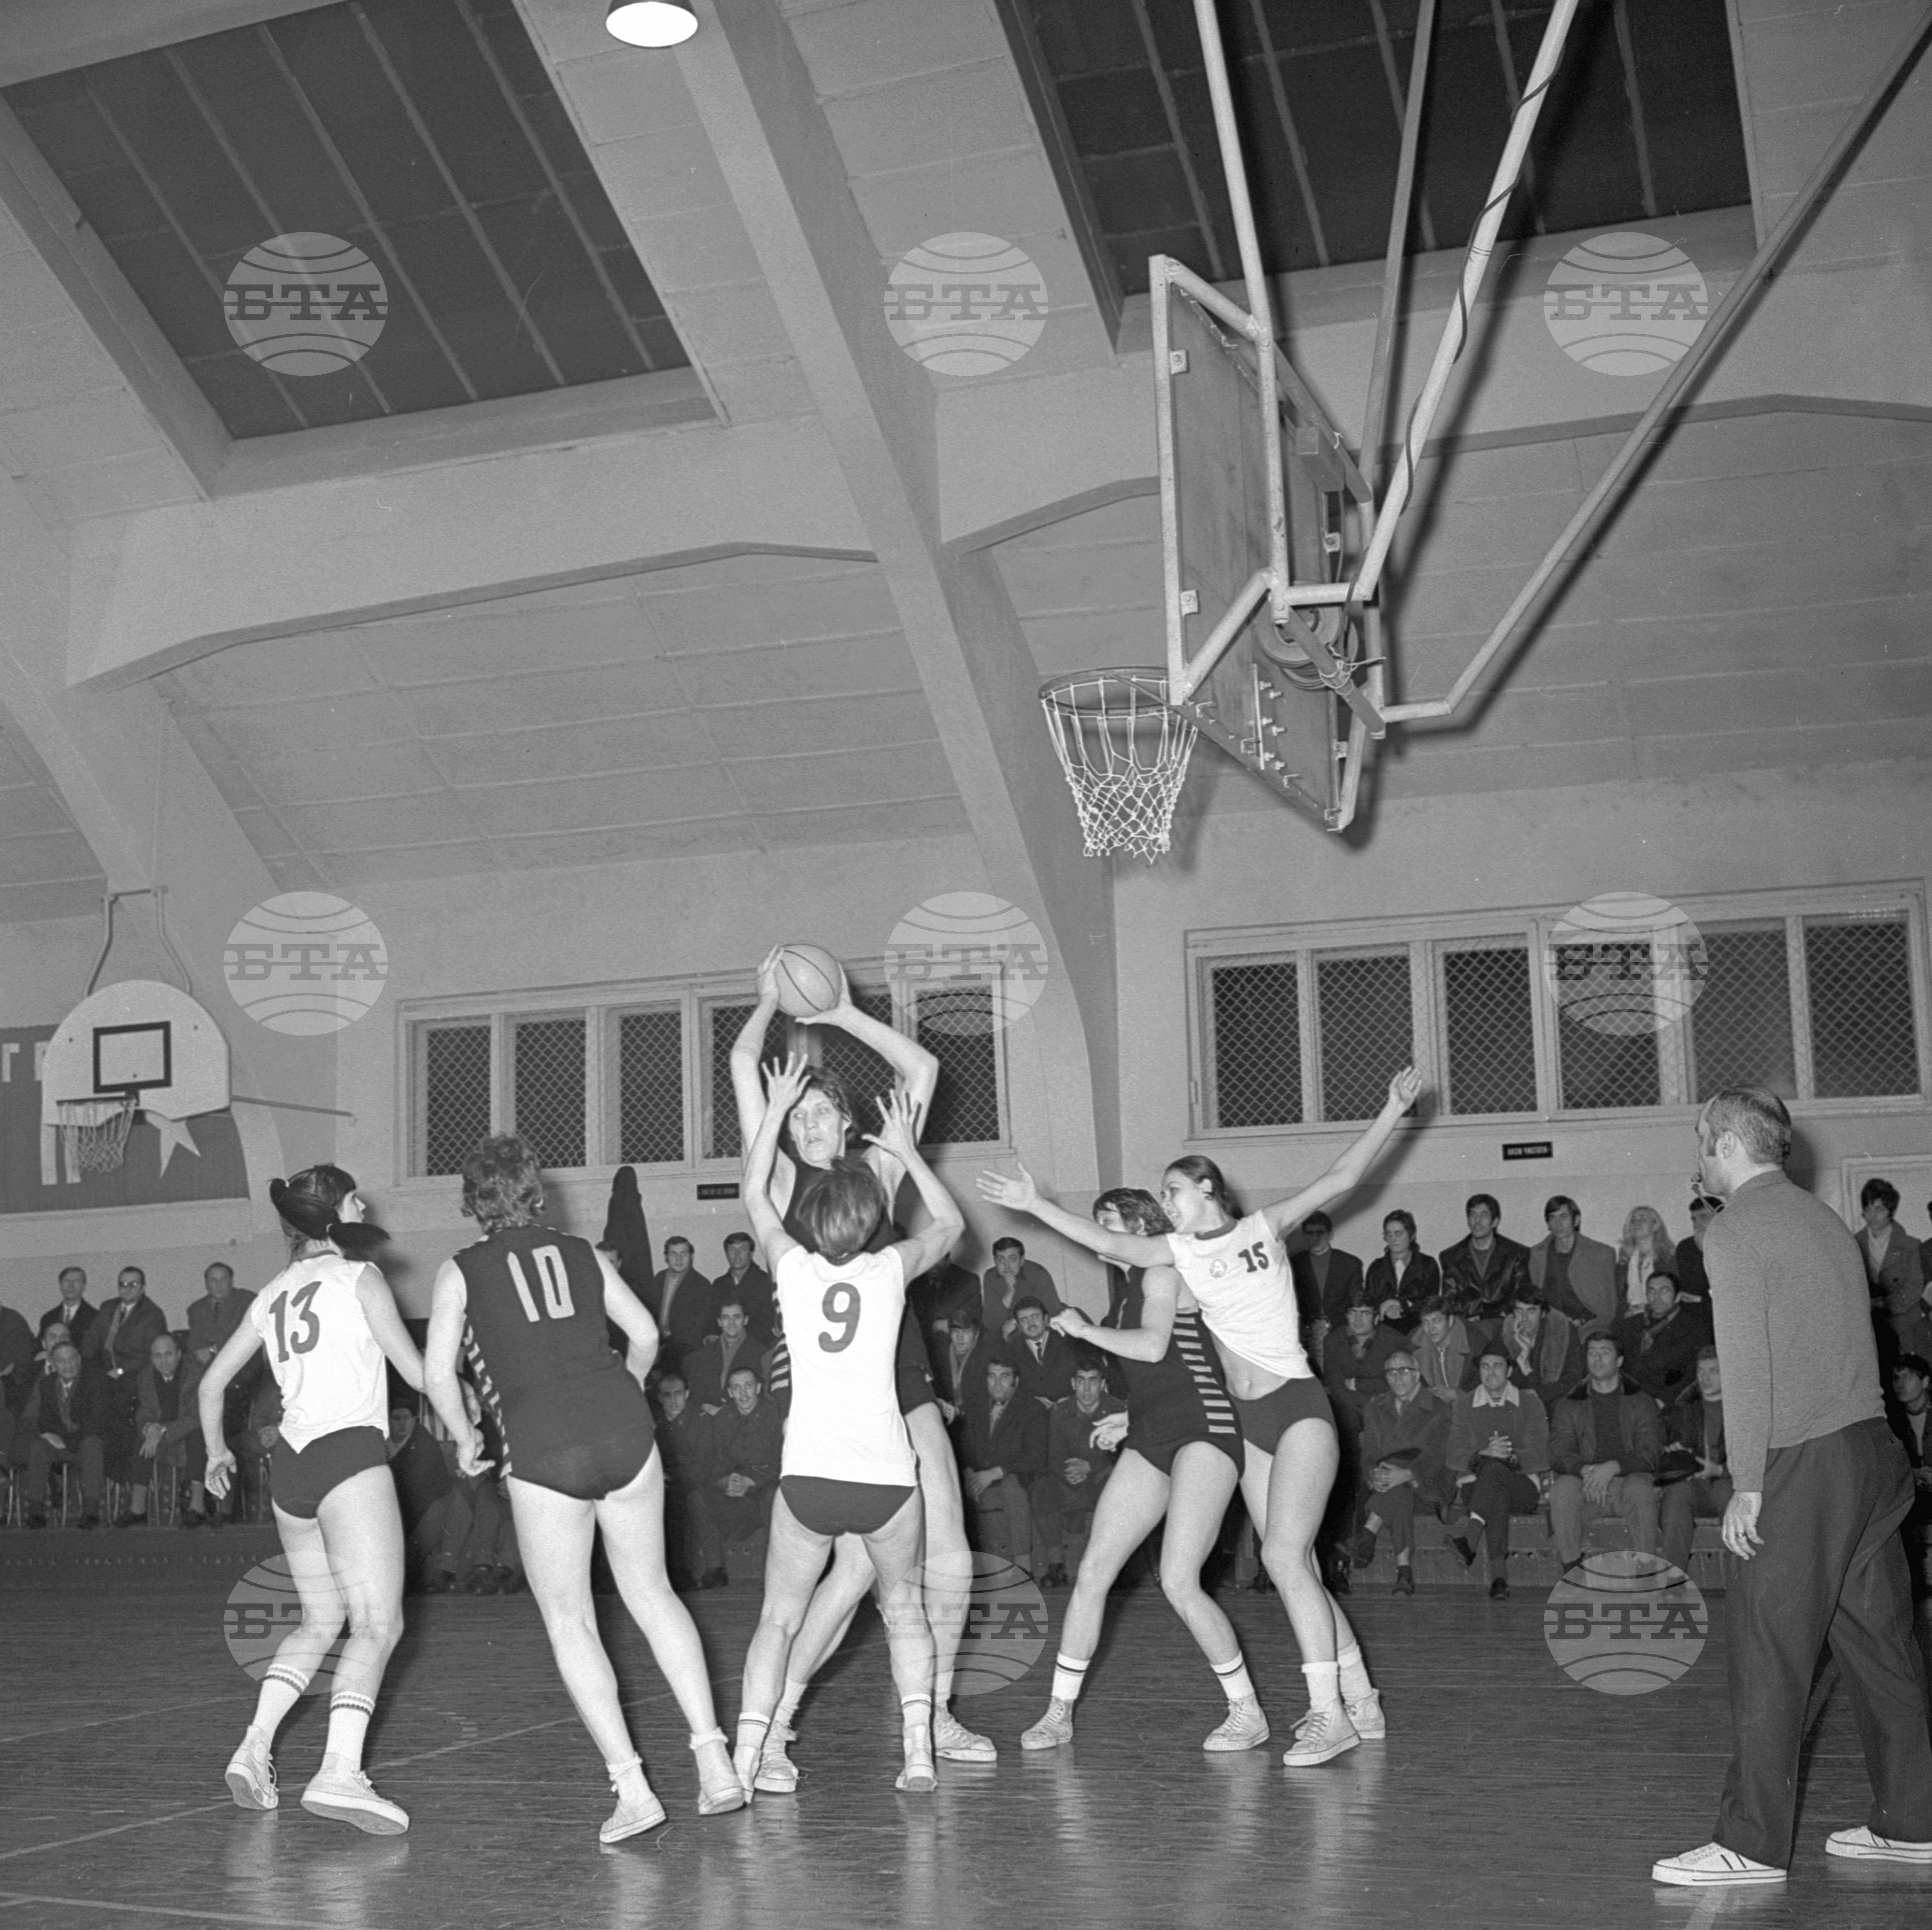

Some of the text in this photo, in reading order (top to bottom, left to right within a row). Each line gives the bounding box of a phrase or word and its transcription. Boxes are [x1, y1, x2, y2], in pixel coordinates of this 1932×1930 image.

[507, 1245, 575, 1322] 10
[1238, 1241, 1269, 1273] 15
[269, 1281, 322, 1362] 13
[818, 1282, 861, 1353] 9
